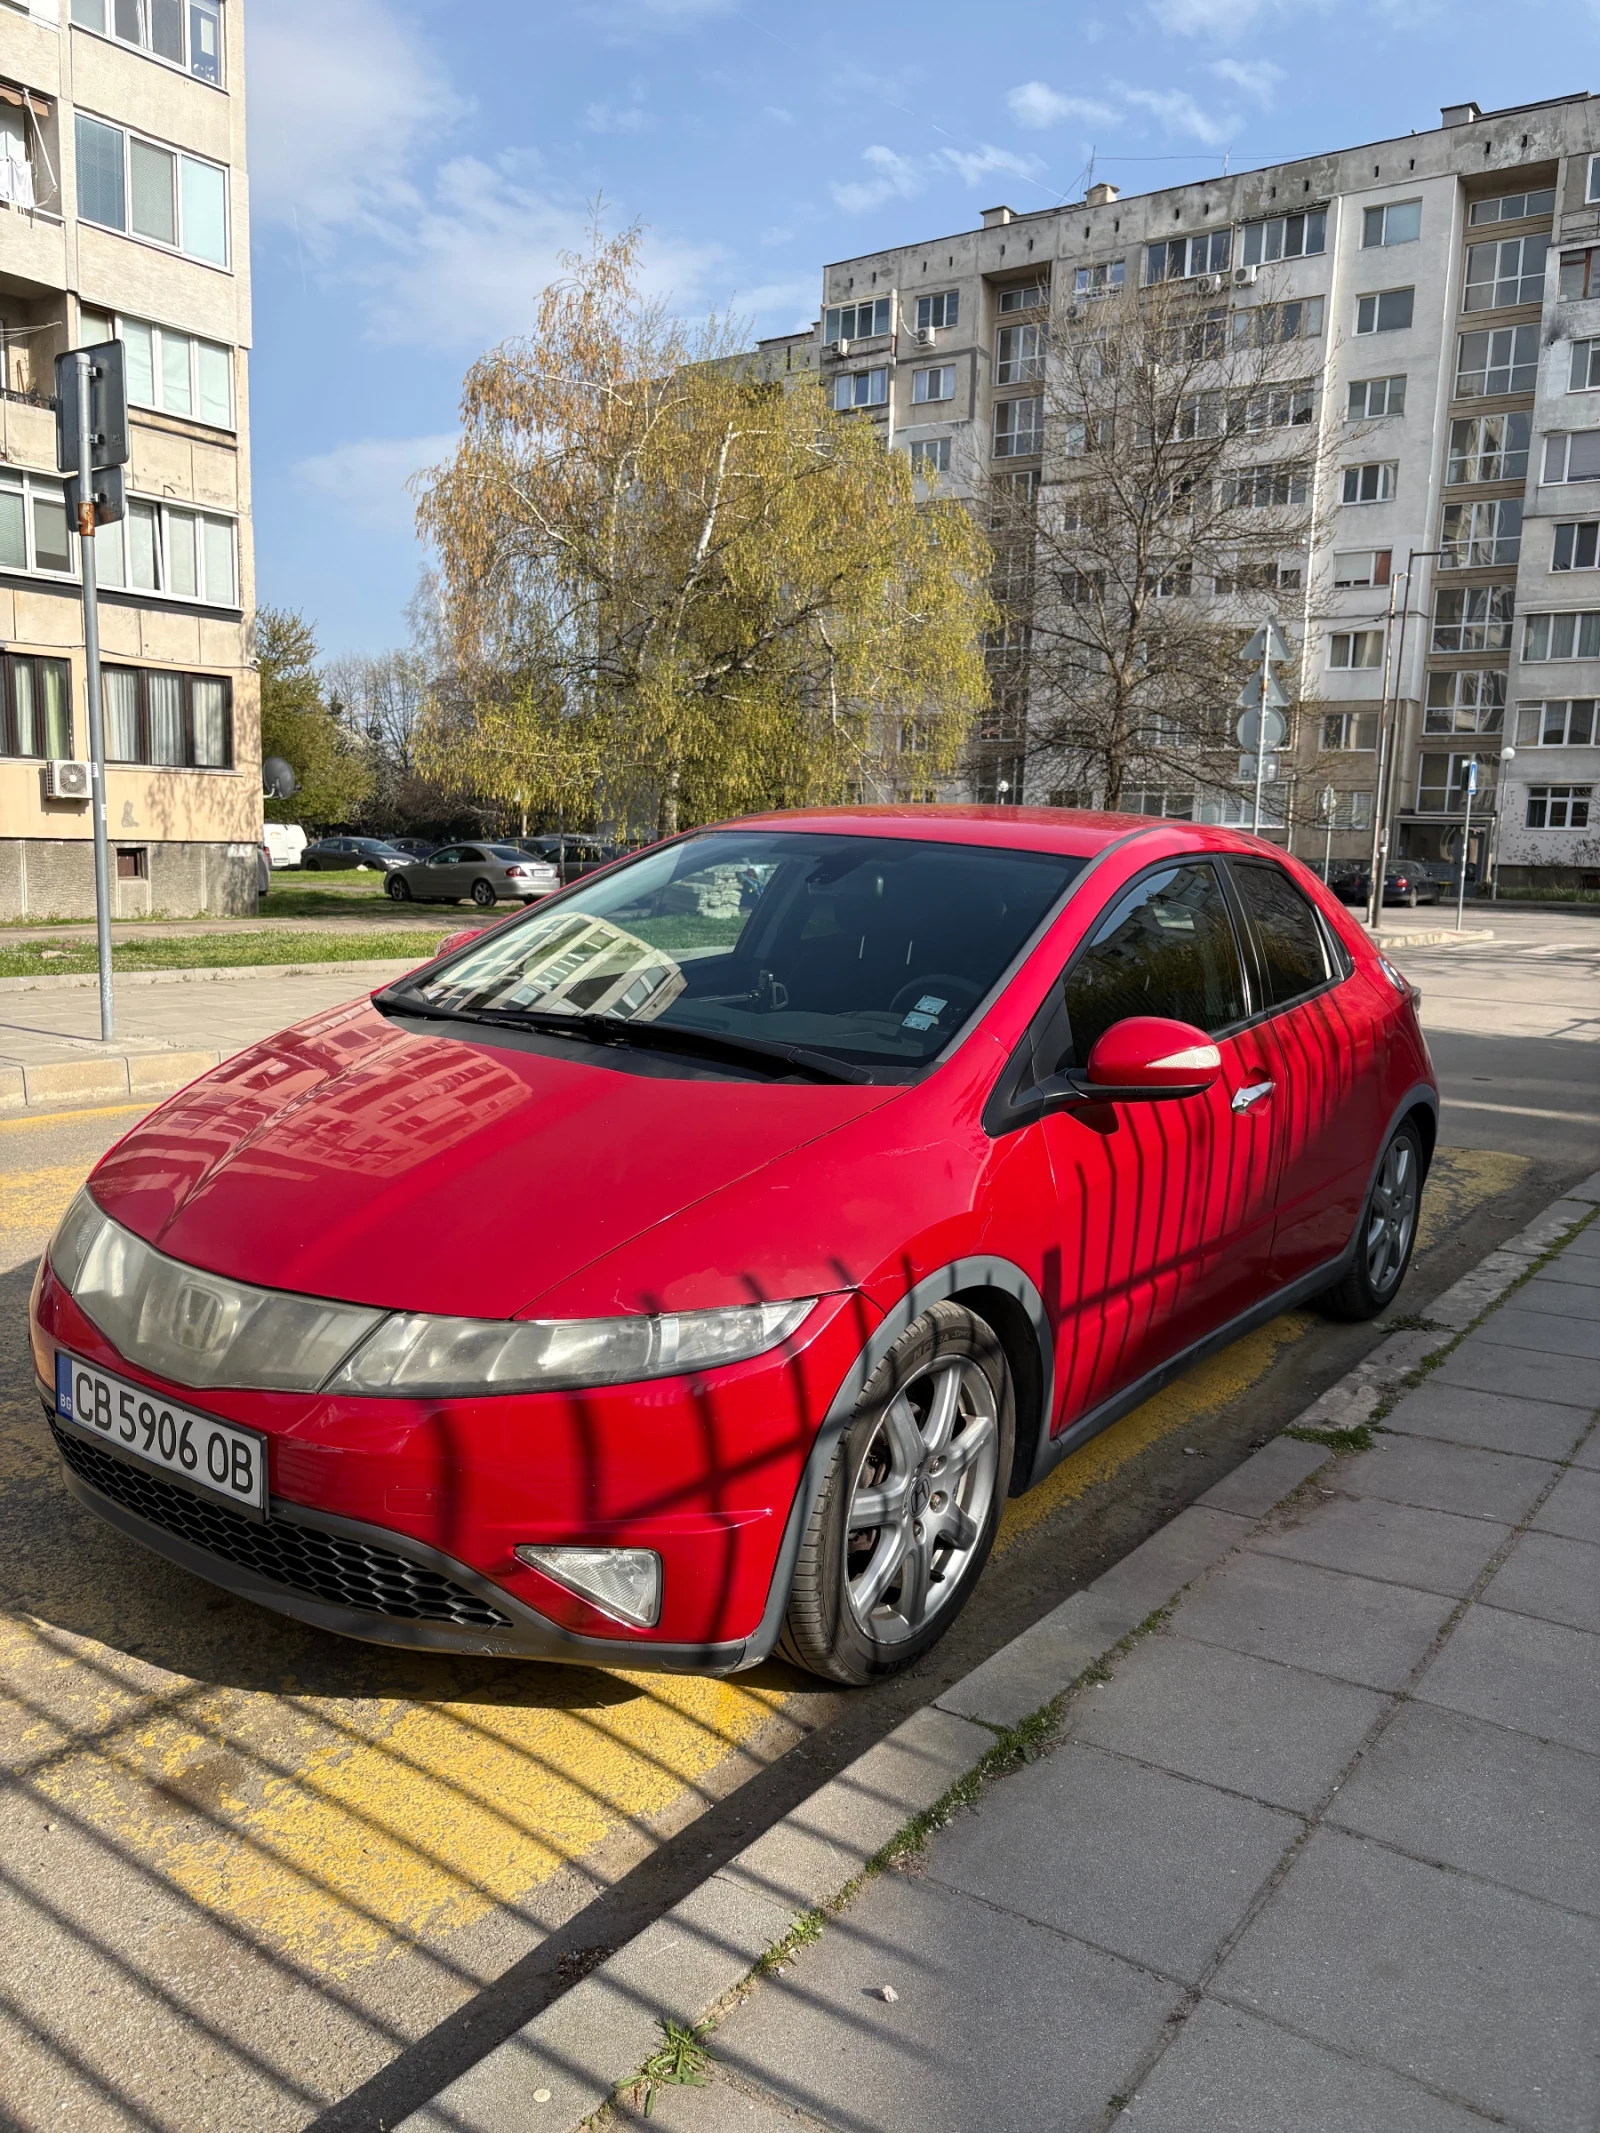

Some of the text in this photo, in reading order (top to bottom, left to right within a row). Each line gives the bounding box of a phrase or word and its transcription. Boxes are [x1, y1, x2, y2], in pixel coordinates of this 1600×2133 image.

[60, 1393, 72, 1411] BG
[76, 1372, 253, 1494] CB 5906 OB
